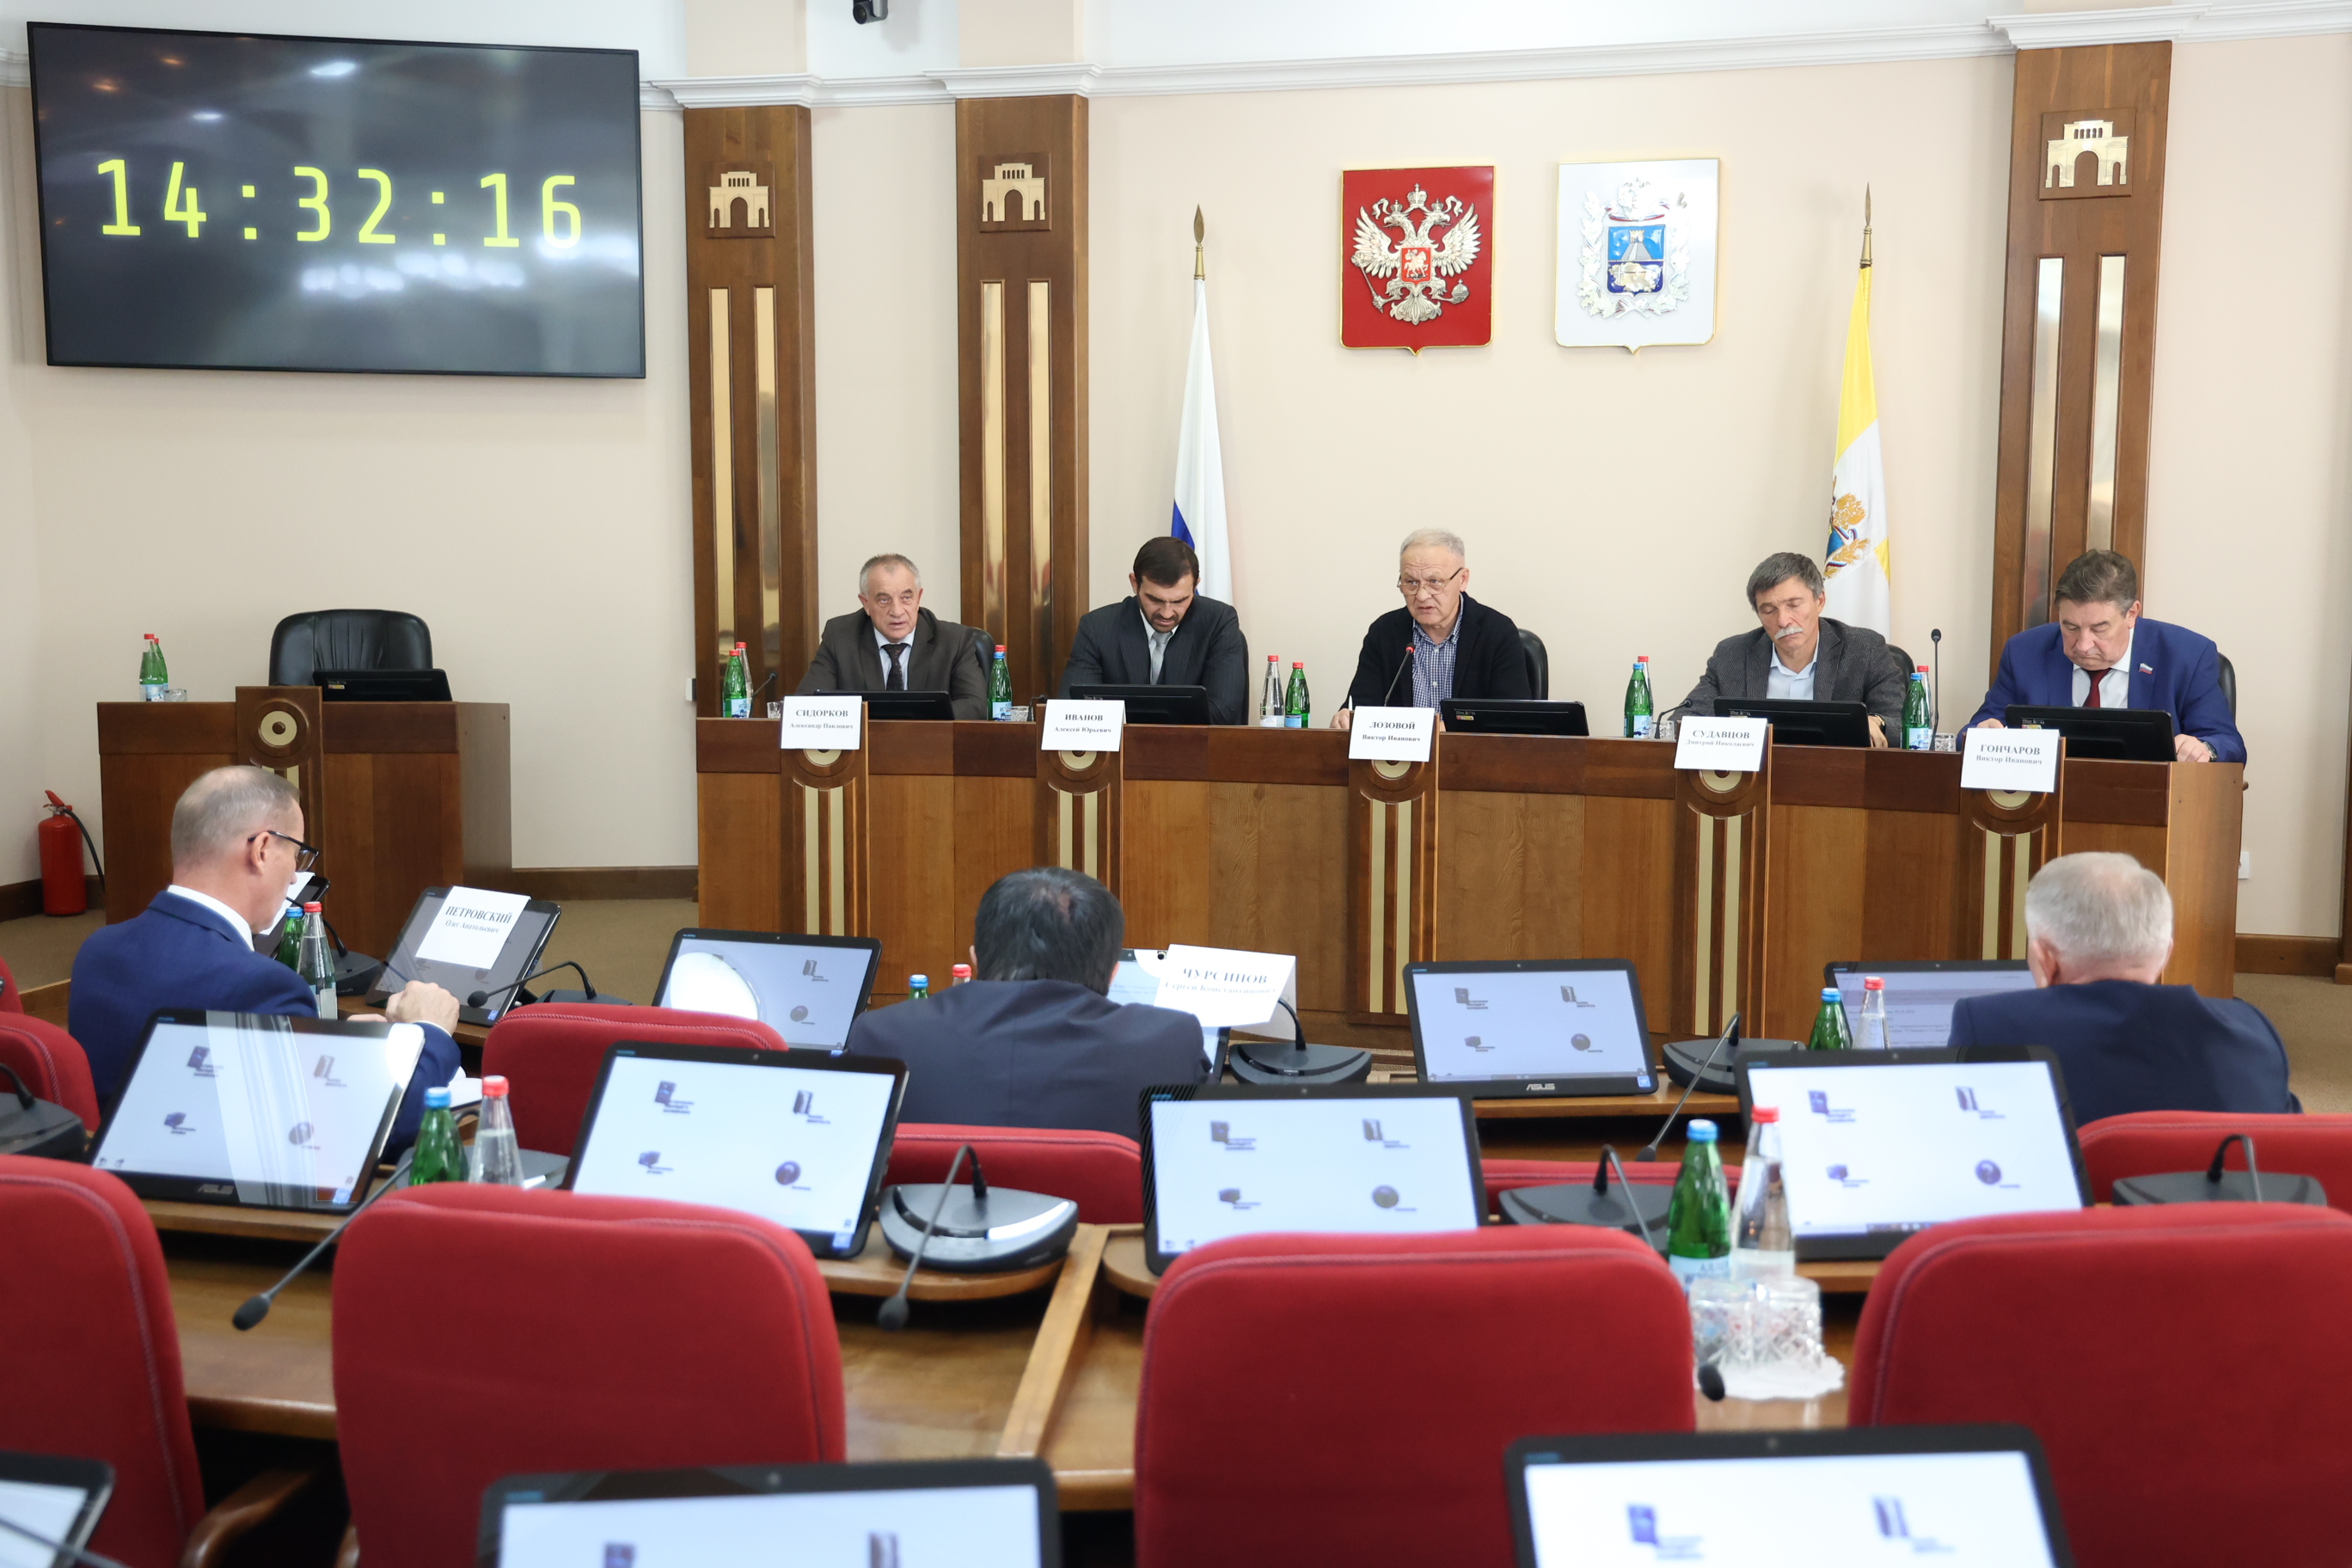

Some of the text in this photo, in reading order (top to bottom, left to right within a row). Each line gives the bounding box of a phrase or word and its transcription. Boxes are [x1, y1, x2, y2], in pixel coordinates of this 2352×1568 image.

[98, 159, 582, 249] 14:32:16
[795, 709, 848, 718] СИДОРКОВ
[1369, 721, 1416, 730] ЛОЗОВОЙ
[1693, 730, 1750, 739] СУДАВЦОВ
[1980, 744, 2041, 756] ГОНЧАРОВ
[1976, 755, 2043, 765] Виктор Иванович
[444, 905, 513, 924] ПЕТРОВСКИЙ
[444, 919, 499, 934] Олег Анатольевич
[1183, 968, 1268, 984] ЧУРСИНОВ
